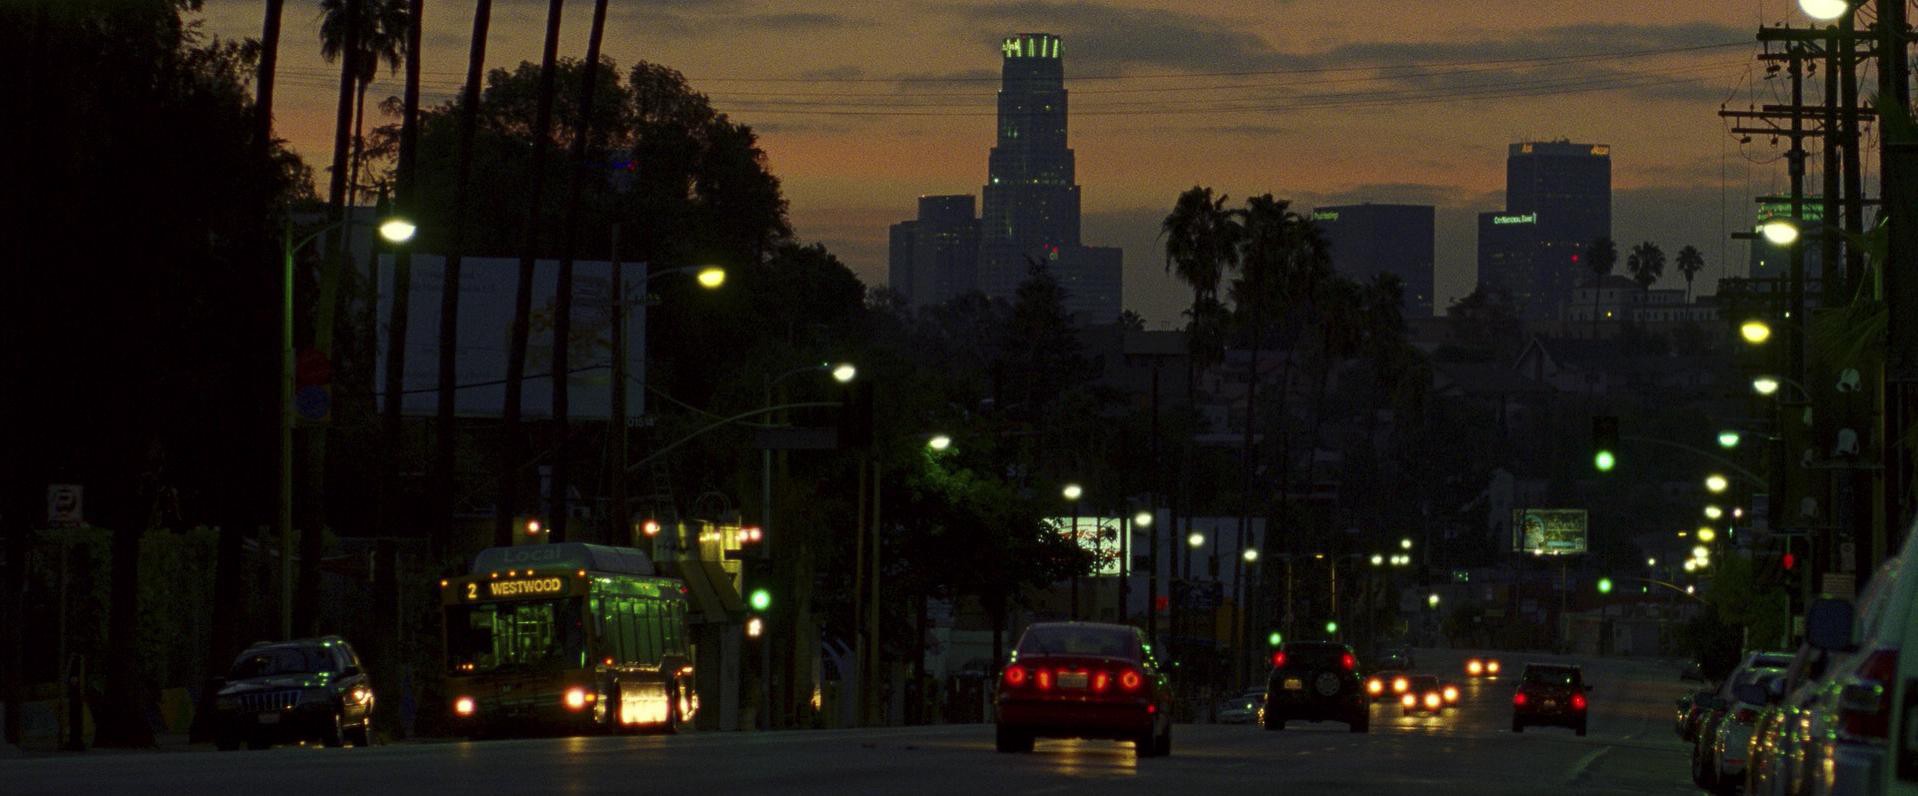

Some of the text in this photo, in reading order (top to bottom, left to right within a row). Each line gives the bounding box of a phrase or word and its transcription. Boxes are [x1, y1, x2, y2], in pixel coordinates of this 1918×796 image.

[503, 546, 562, 563] Local
[467, 578, 562, 599] 2 WESTWOOD
